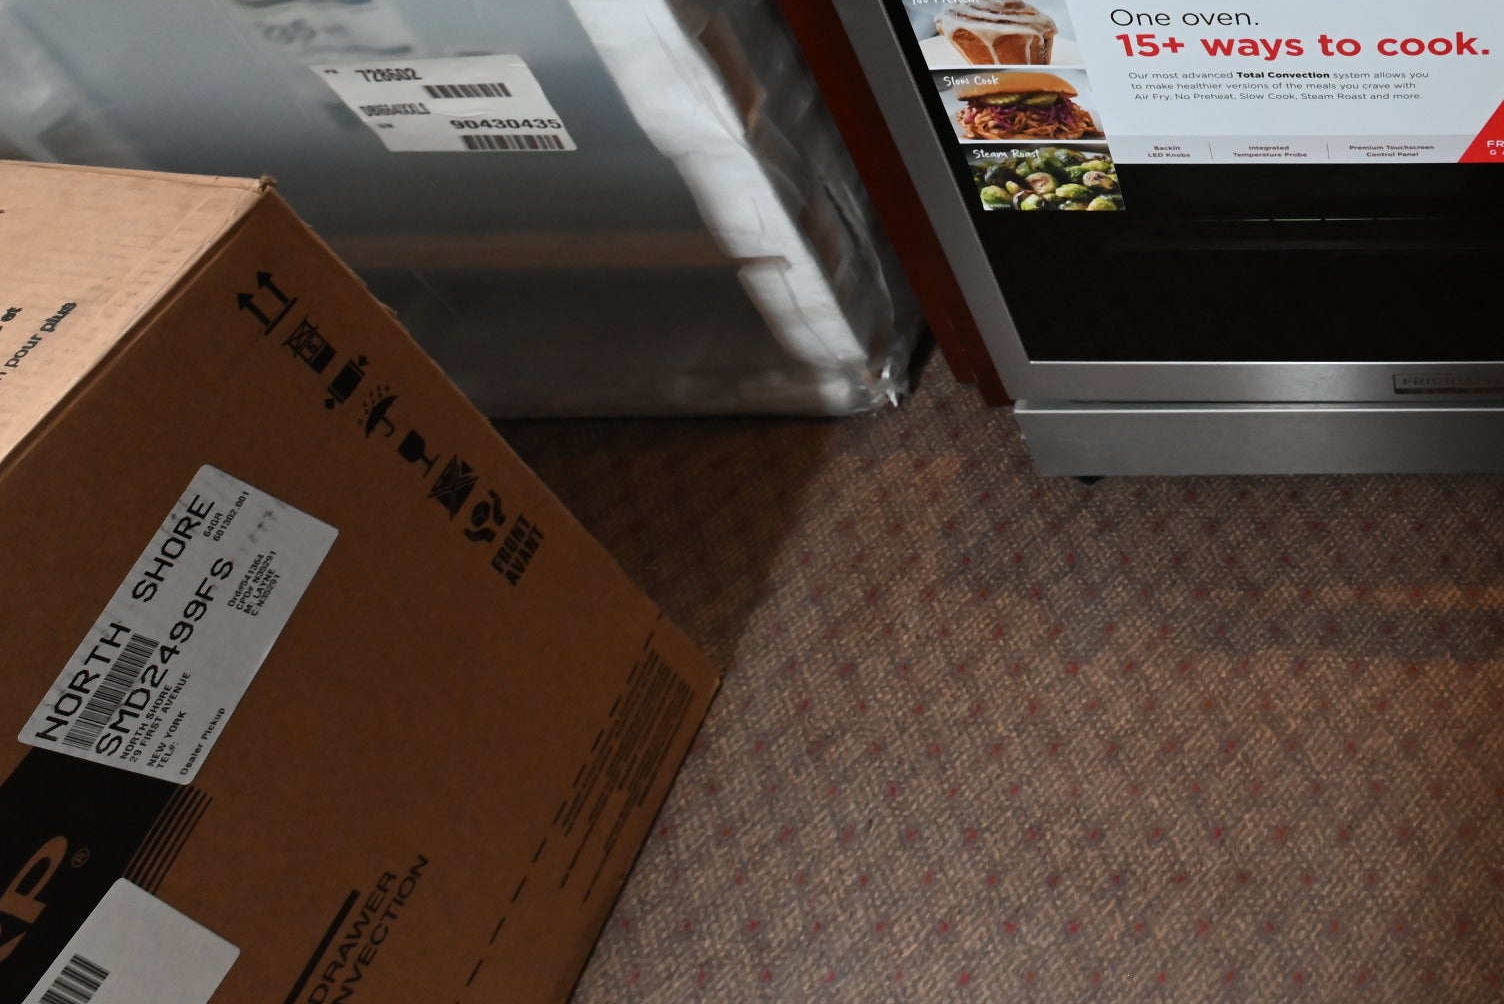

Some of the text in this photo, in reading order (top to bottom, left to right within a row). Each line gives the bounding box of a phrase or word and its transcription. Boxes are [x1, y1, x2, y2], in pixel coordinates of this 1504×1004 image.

[1110, 8, 1259, 26] One oven.
[1115, 31, 1490, 61] 15+ ways to cook.
[355, 67, 423, 83] 728602
[943, 75, 999, 87] Slow Cook
[1177, 82, 1222, 90] healthier
[1272, 82, 1282, 90] of
[1286, 82, 1303, 90] the
[1306, 82, 1337, 90] meals
[1182, 71, 1234, 79] advanced
[1236, 71, 1265, 79] Total
[1267, 71, 1330, 79] Convection
[1333, 71, 1370, 80] system
[1373, 71, 1406, 79] allows
[1409, 72, 1429, 80] you
[1152, 93, 1173, 101] Fry,
[1194, 93, 1237, 101] Preheat,
[1239, 92, 1265, 100] Slow
[1268, 92, 1298, 101] Cook,
[1301, 92, 1334, 100] Steam
[1337, 92, 1366, 100] Roast
[1370, 92, 1390, 100] and
[450, 118, 562, 130] 90430435
[972, 149, 1040, 159] Steam Roast
[4, 301, 78, 368] pour plus
[203, 511, 224, 538] 64GR
[213, 490, 250, 542] 601302.001
[491, 513, 532, 573] FRONT
[506, 524, 544, 586] AVANT
[252, 550, 277, 584] N35291
[254, 568, 276, 600] LAYNE
[35, 494, 216, 742] NORTH SHORE
[95, 557, 234, 757] SMD2499FS
[120, 684, 173, 759] NORTH SHORE
[129, 672, 191, 763] 29 FIRST AVENUE
[146, 710, 187, 767] NEW YORK
[180, 707, 226, 775] Dealer Pickup
[308, 871, 398, 1004] DRAWER
